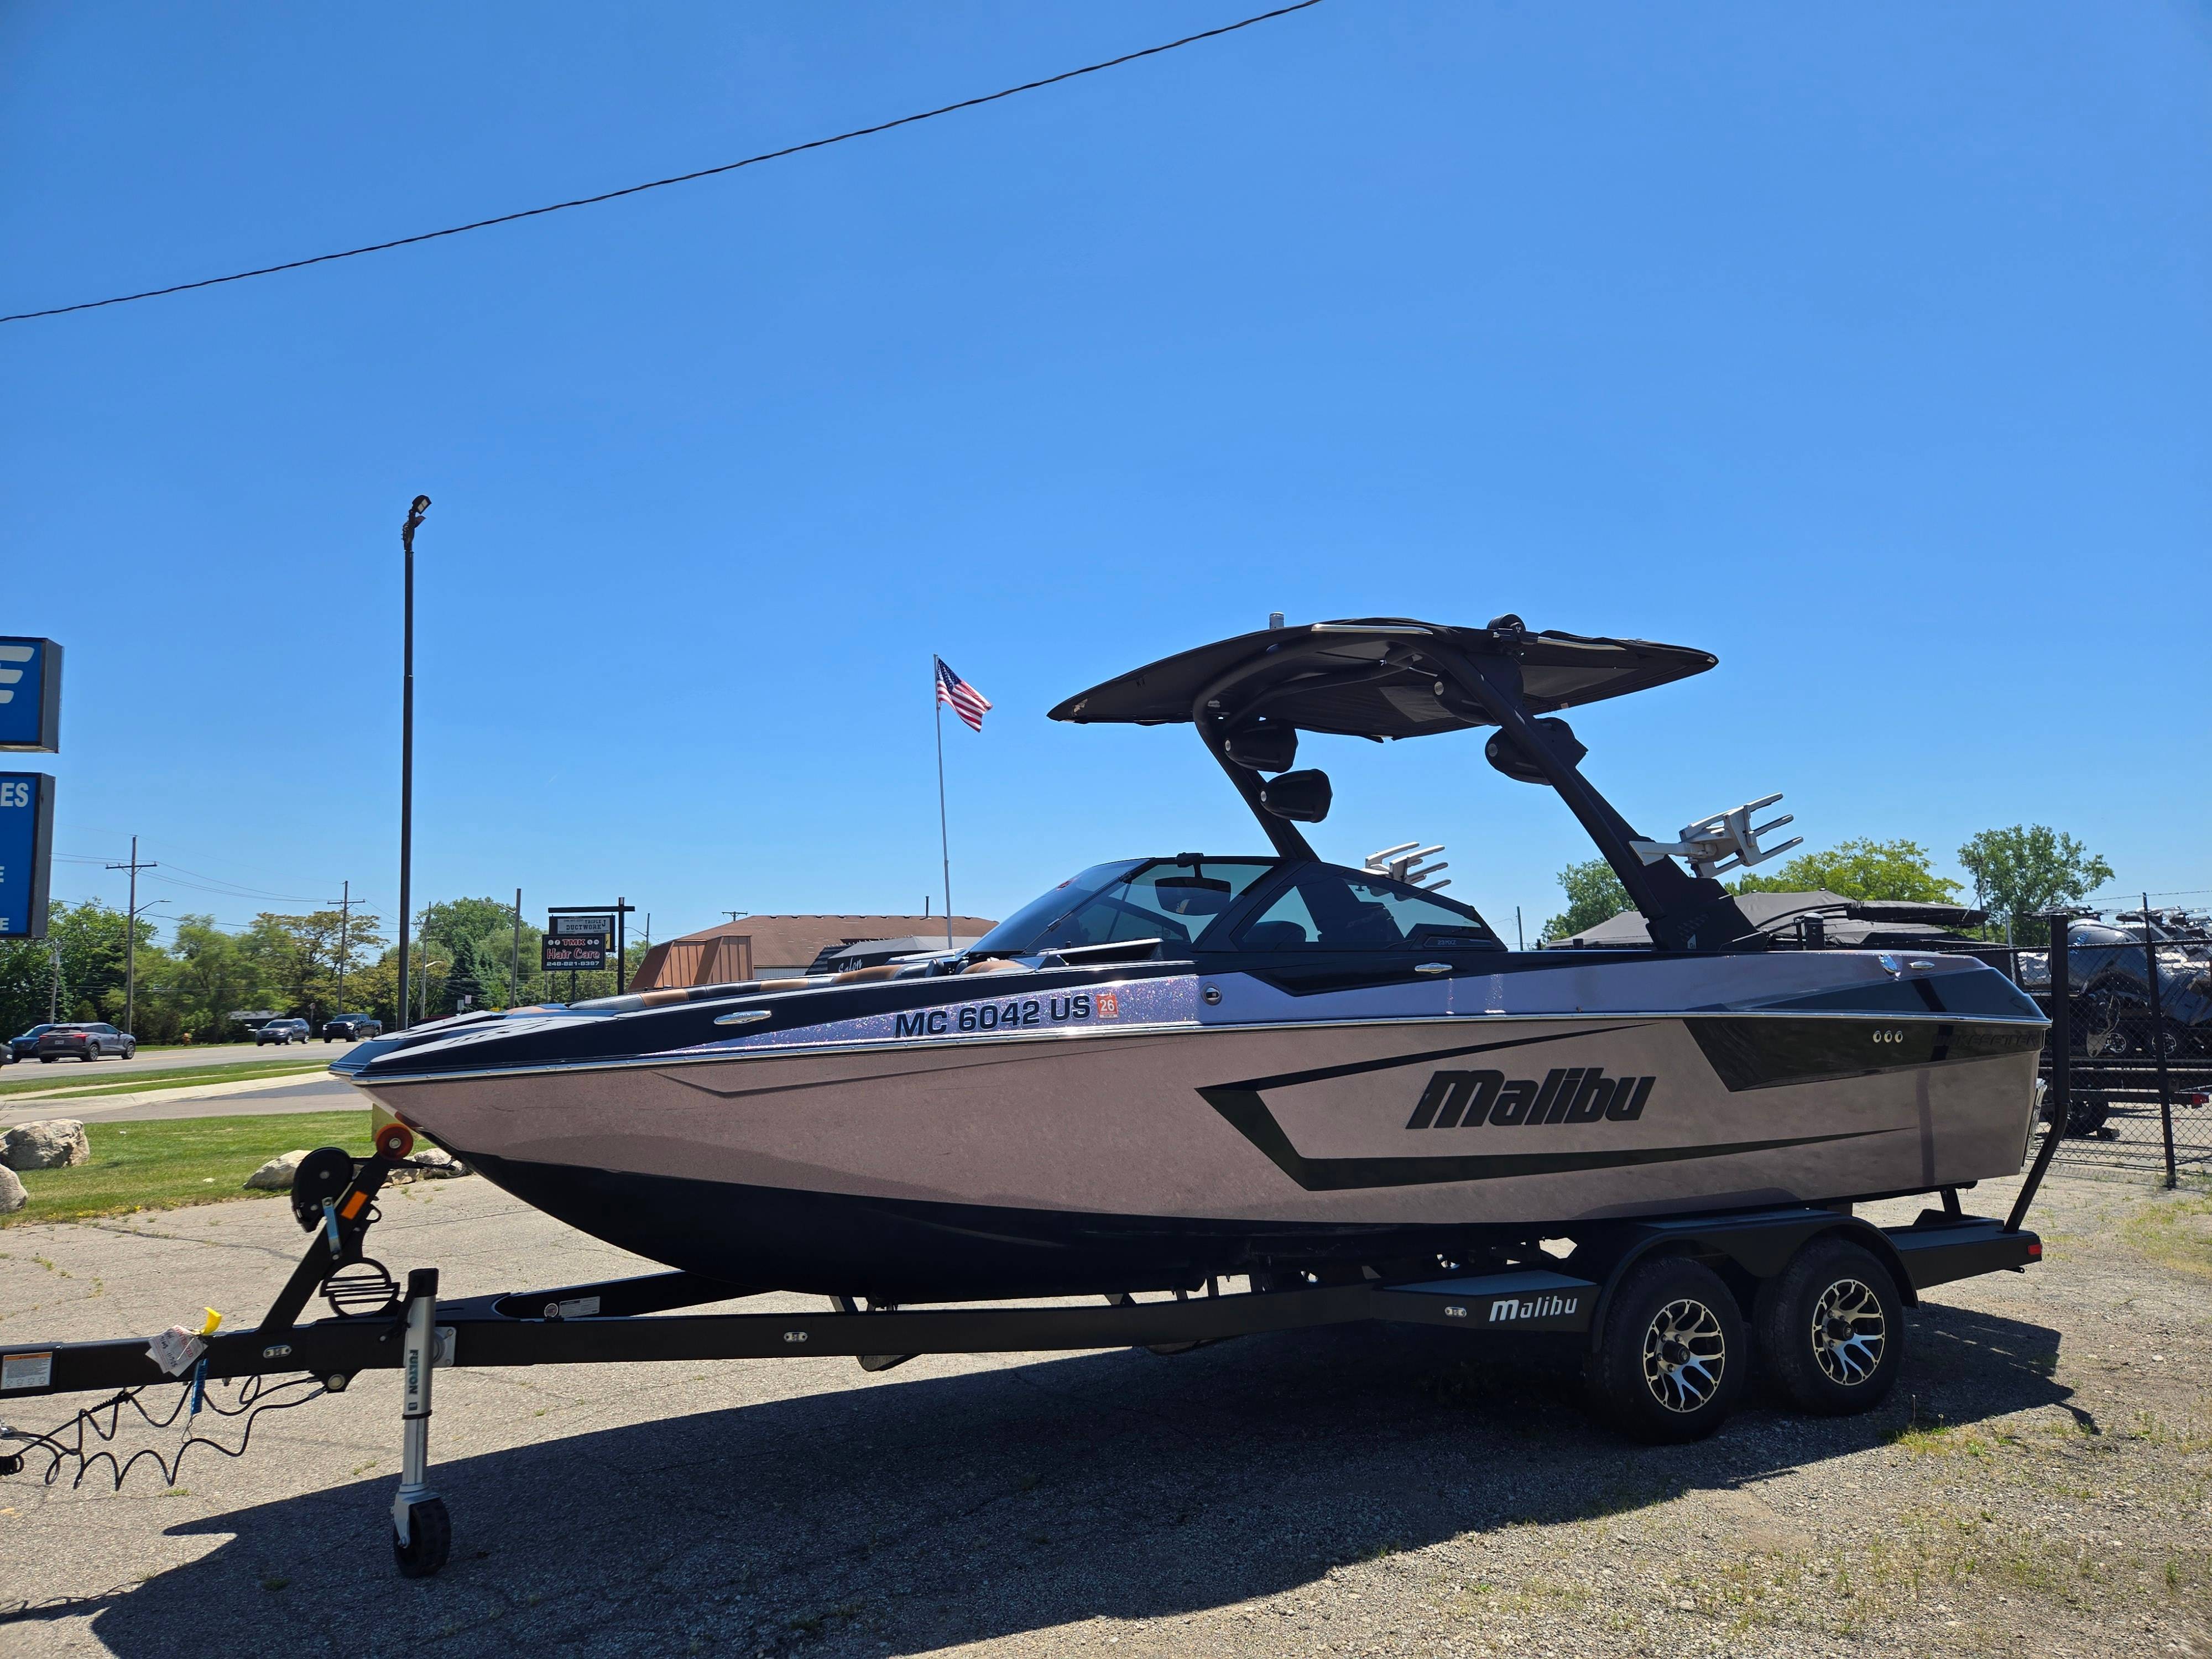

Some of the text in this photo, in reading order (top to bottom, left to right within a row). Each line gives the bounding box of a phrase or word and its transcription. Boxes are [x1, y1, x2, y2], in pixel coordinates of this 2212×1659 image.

[546, 947, 600, 959] Hair Care
[838, 957, 863, 973] Salon
[894, 995, 1091, 1038] MC 6042 US
[1099, 999, 1115, 1011] 26
[1405, 1067, 1657, 1129] Malibu
[409, 1349, 418, 1394] FULTON
